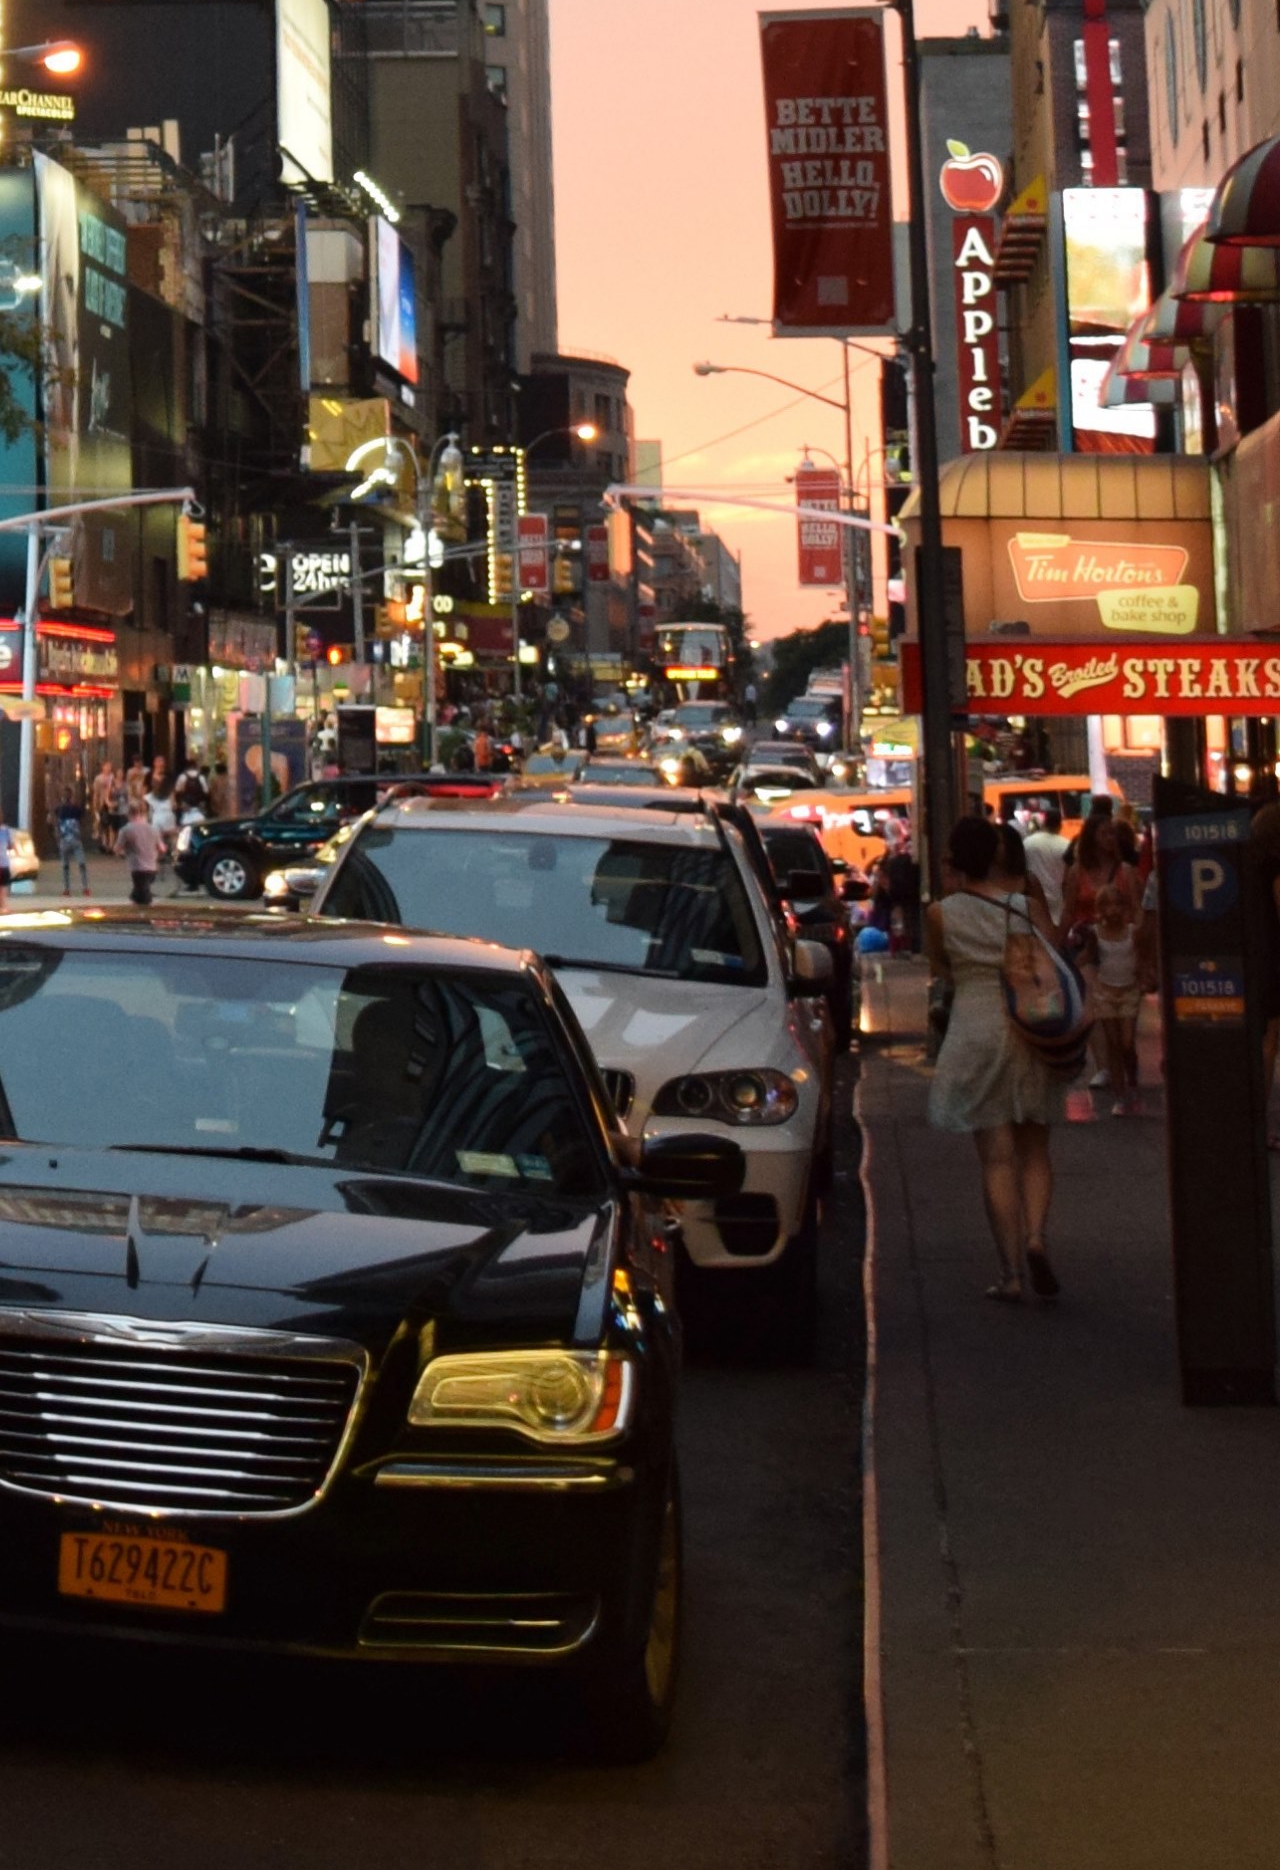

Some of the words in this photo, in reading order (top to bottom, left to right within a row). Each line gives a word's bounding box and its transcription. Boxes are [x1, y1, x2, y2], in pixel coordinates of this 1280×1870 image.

[775, 96, 877, 126] BETTE
[770, 125, 885, 156] MIDLER
[781, 160, 880, 189] HELLO,
[782, 187, 881, 220] DOLLY!
[291, 552, 351, 574] OPEN
[1024, 554, 1070, 583] Tim
[1072, 554, 1164, 584] Hortons
[1118, 593, 1165, 609] coffee
[1167, 595, 1180, 609] &
[1110, 608, 1149, 623] bake
[1151, 610, 1187, 626] shop
[1047, 651, 1119, 689] Broiled
[1122, 656, 1280, 699] STEAKS
[1184, 824, 1239, 840] 101518
[1191, 858, 1226, 911] P
[1181, 980, 1235, 995] 101518
[73, 1537, 214, 1595] T629422C
